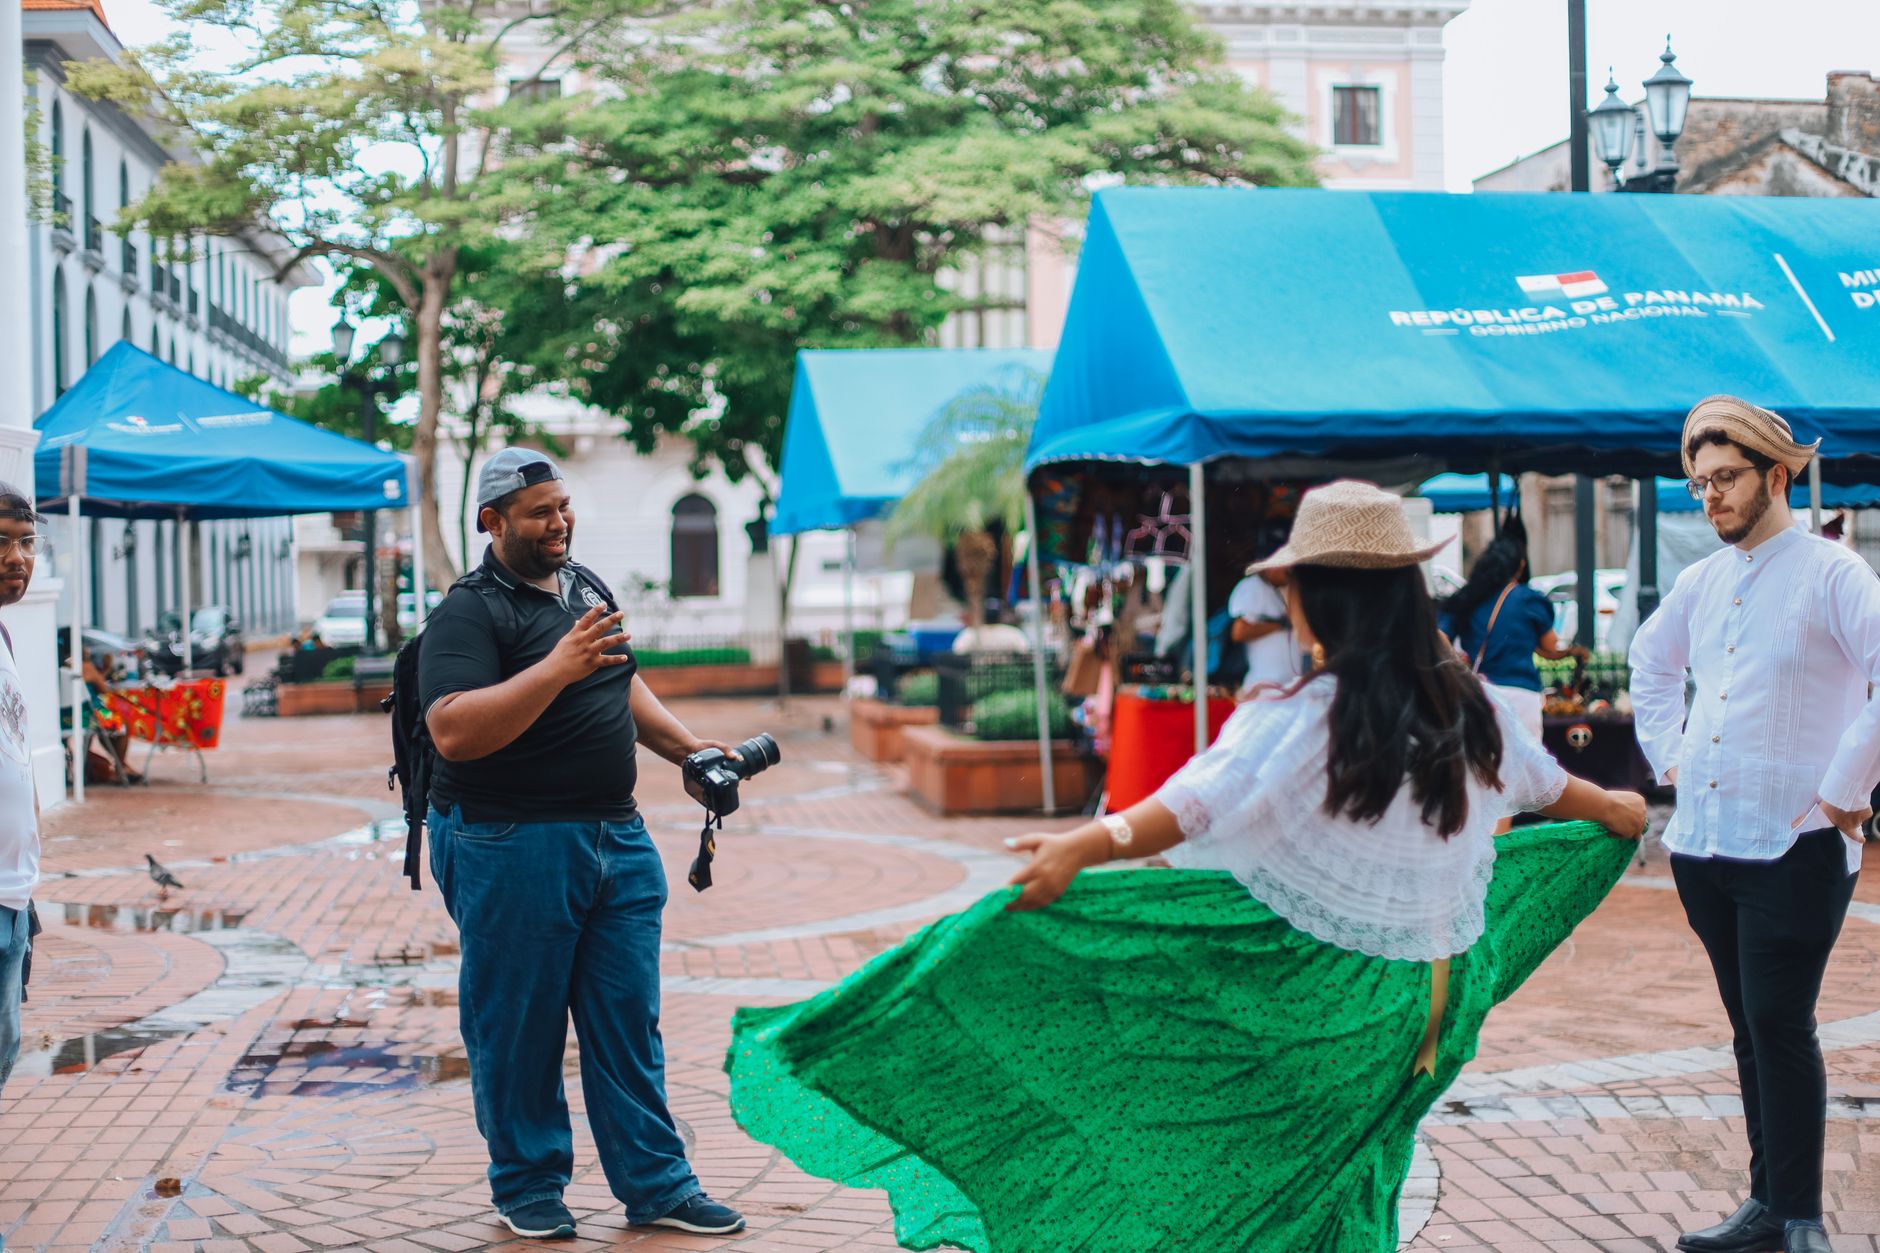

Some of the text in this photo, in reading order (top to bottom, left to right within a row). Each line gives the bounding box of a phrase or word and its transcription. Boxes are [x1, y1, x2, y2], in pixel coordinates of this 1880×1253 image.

[1388, 290, 1766, 327] REPÚBLICA DE PANAMÁ
[1469, 305, 1709, 337] GOBIERNO NACIONAL
